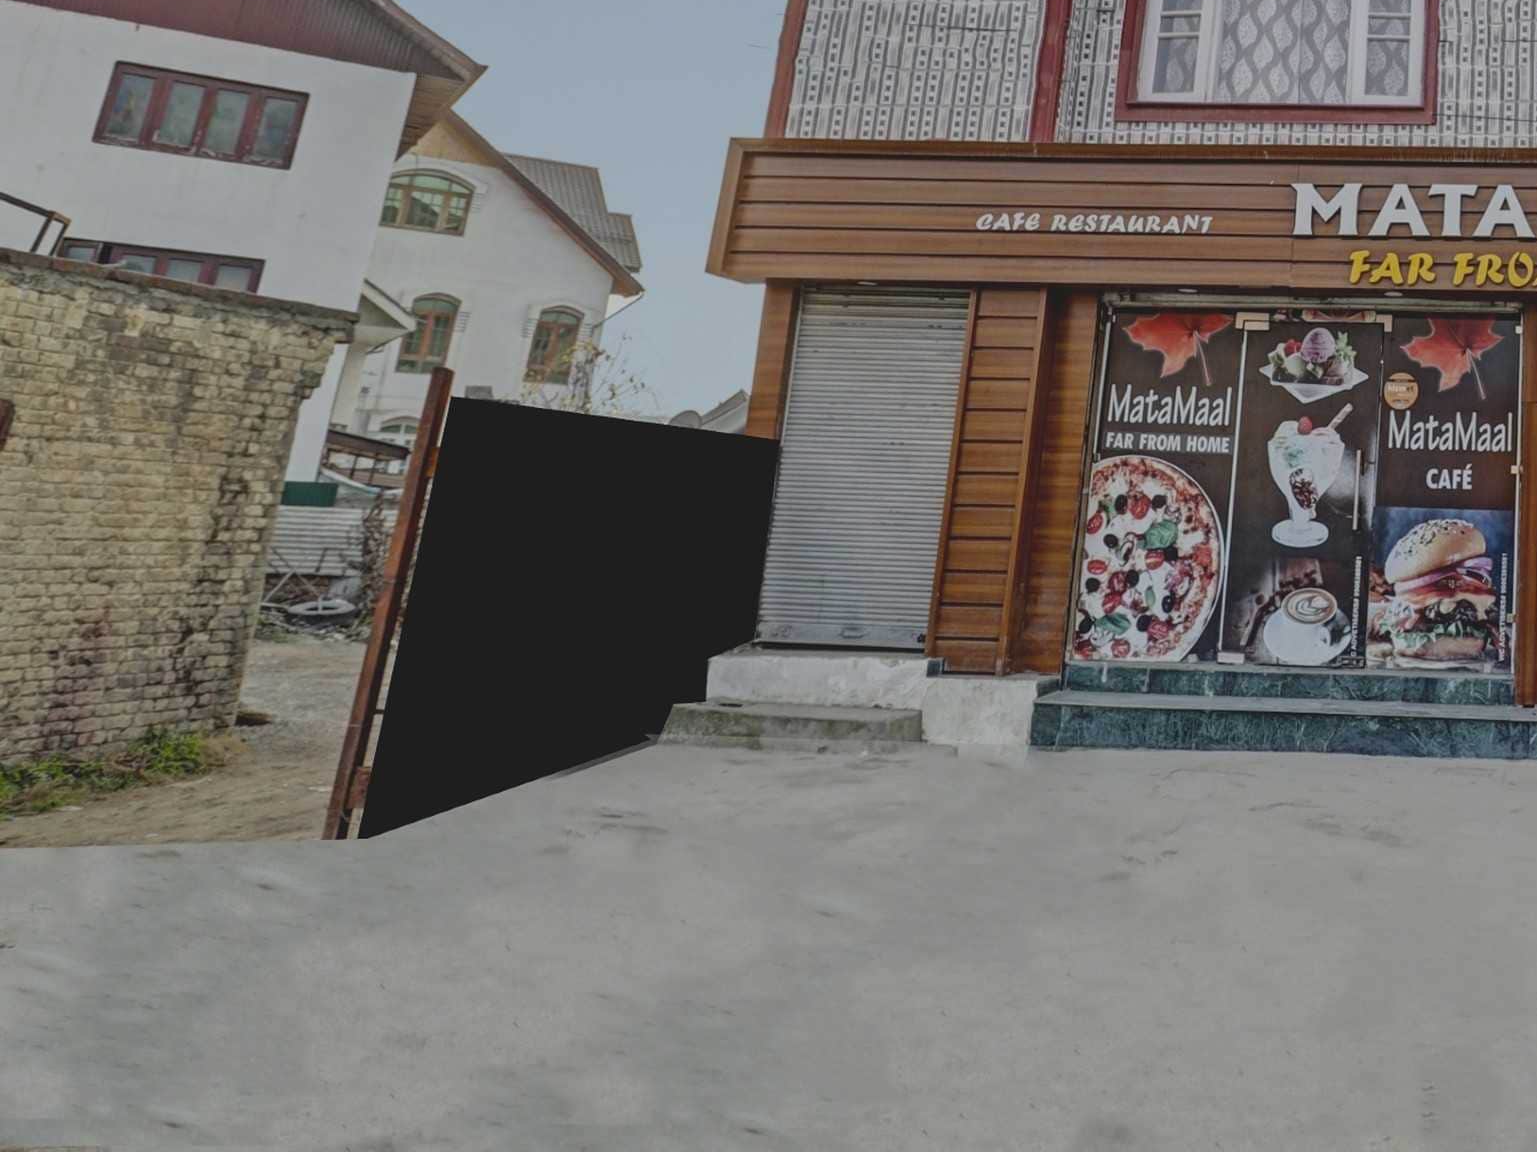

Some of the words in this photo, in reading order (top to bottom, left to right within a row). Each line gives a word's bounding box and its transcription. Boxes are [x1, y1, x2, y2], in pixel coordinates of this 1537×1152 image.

[975, 212, 1041, 232] CAFE
[1050, 213, 1213, 234] RESTAURANT
[1349, 250, 1437, 285] FAR
[1107, 384, 1233, 427] MataMaal
[1105, 432, 1135, 449] FAR
[1139, 433, 1181, 451] FROM
[1186, 435, 1231, 454] HOME
[1388, 410, 1513, 452] MataMaal
[1426, 463, 1473, 490] CAFÉ
